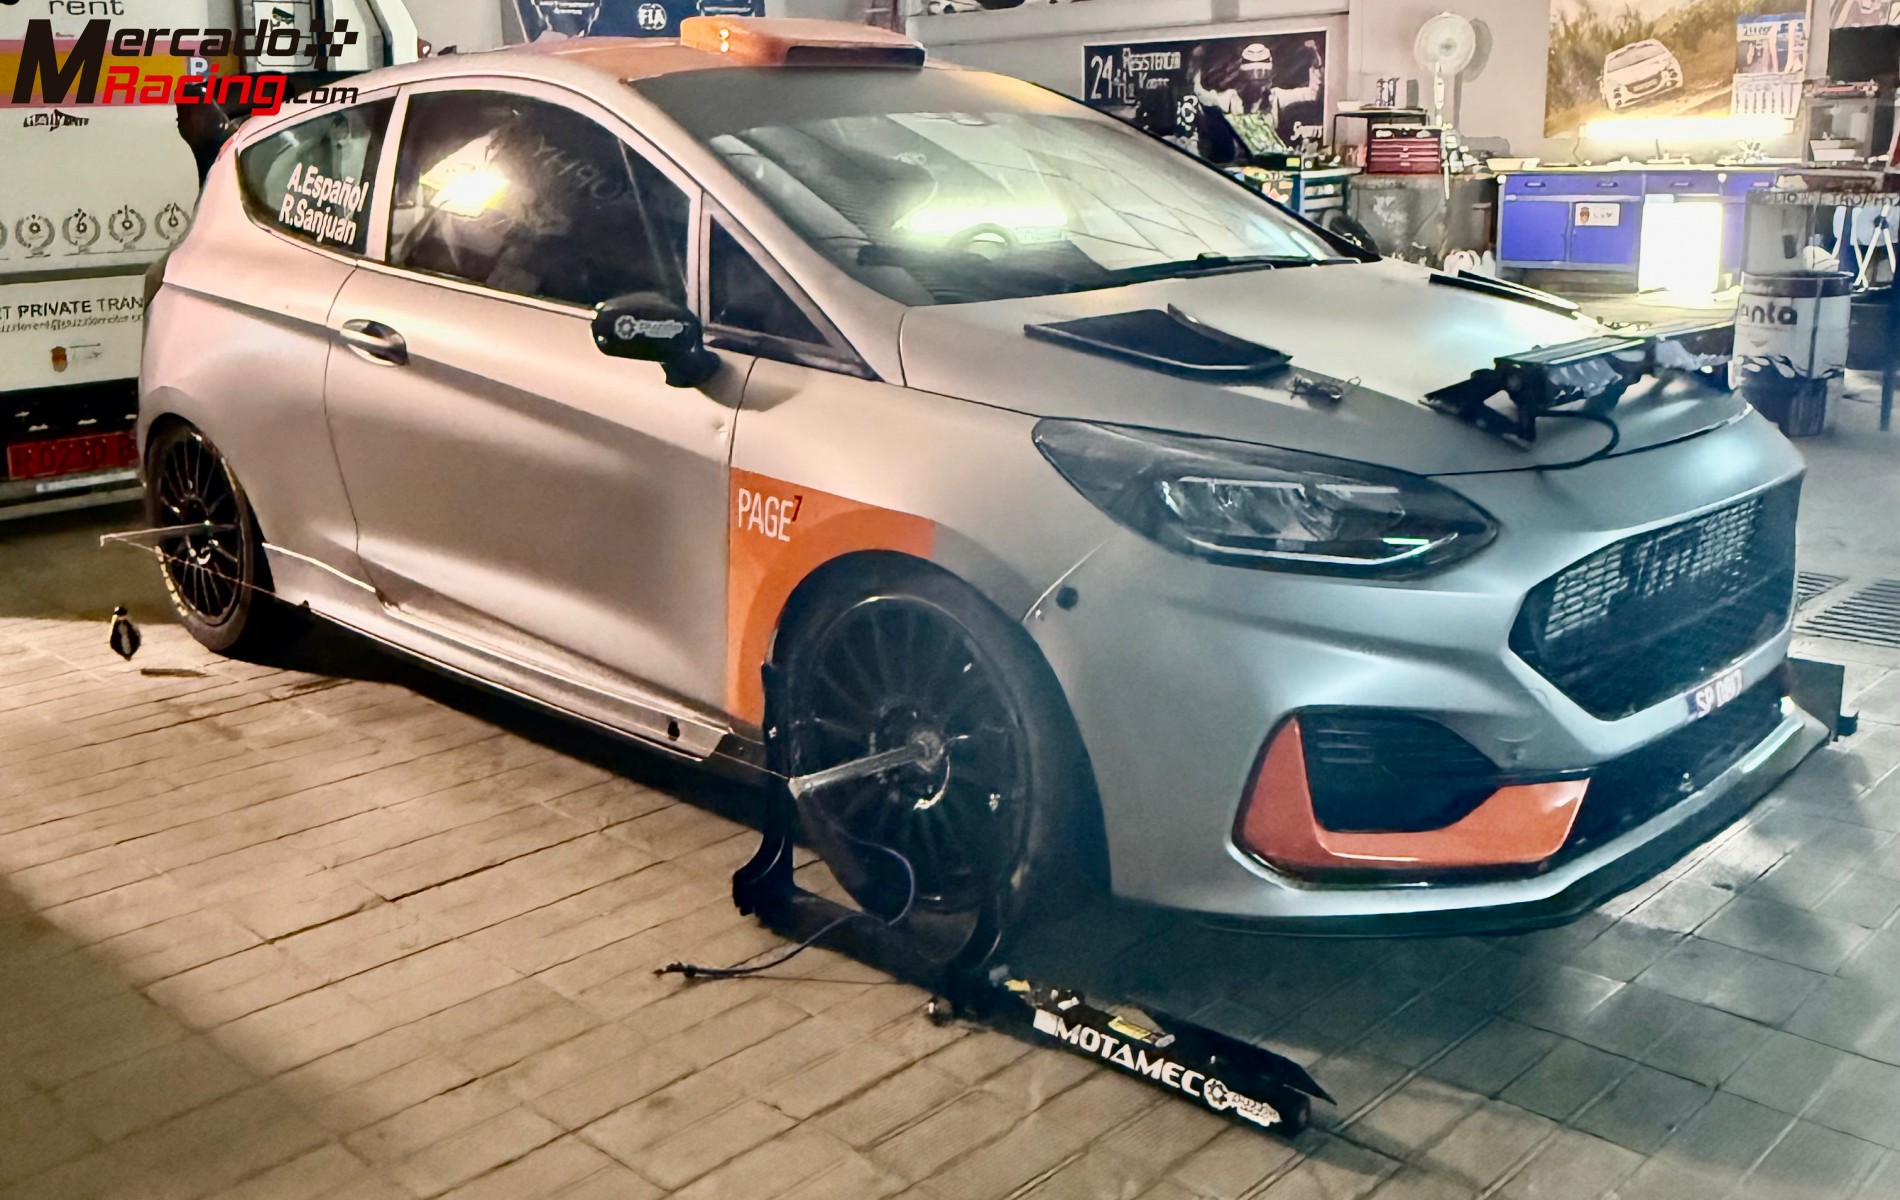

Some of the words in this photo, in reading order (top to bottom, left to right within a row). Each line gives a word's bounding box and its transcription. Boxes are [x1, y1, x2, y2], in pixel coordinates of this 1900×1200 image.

[48, 0, 124, 15] rent
[638, 4, 667, 30] FIA
[286, 162, 370, 212] A.Español
[279, 193, 357, 246] R.Sanjuan
[18, 300, 92, 317] PRIVATE
[1053, 1023, 1205, 1097] MOTAMEC
